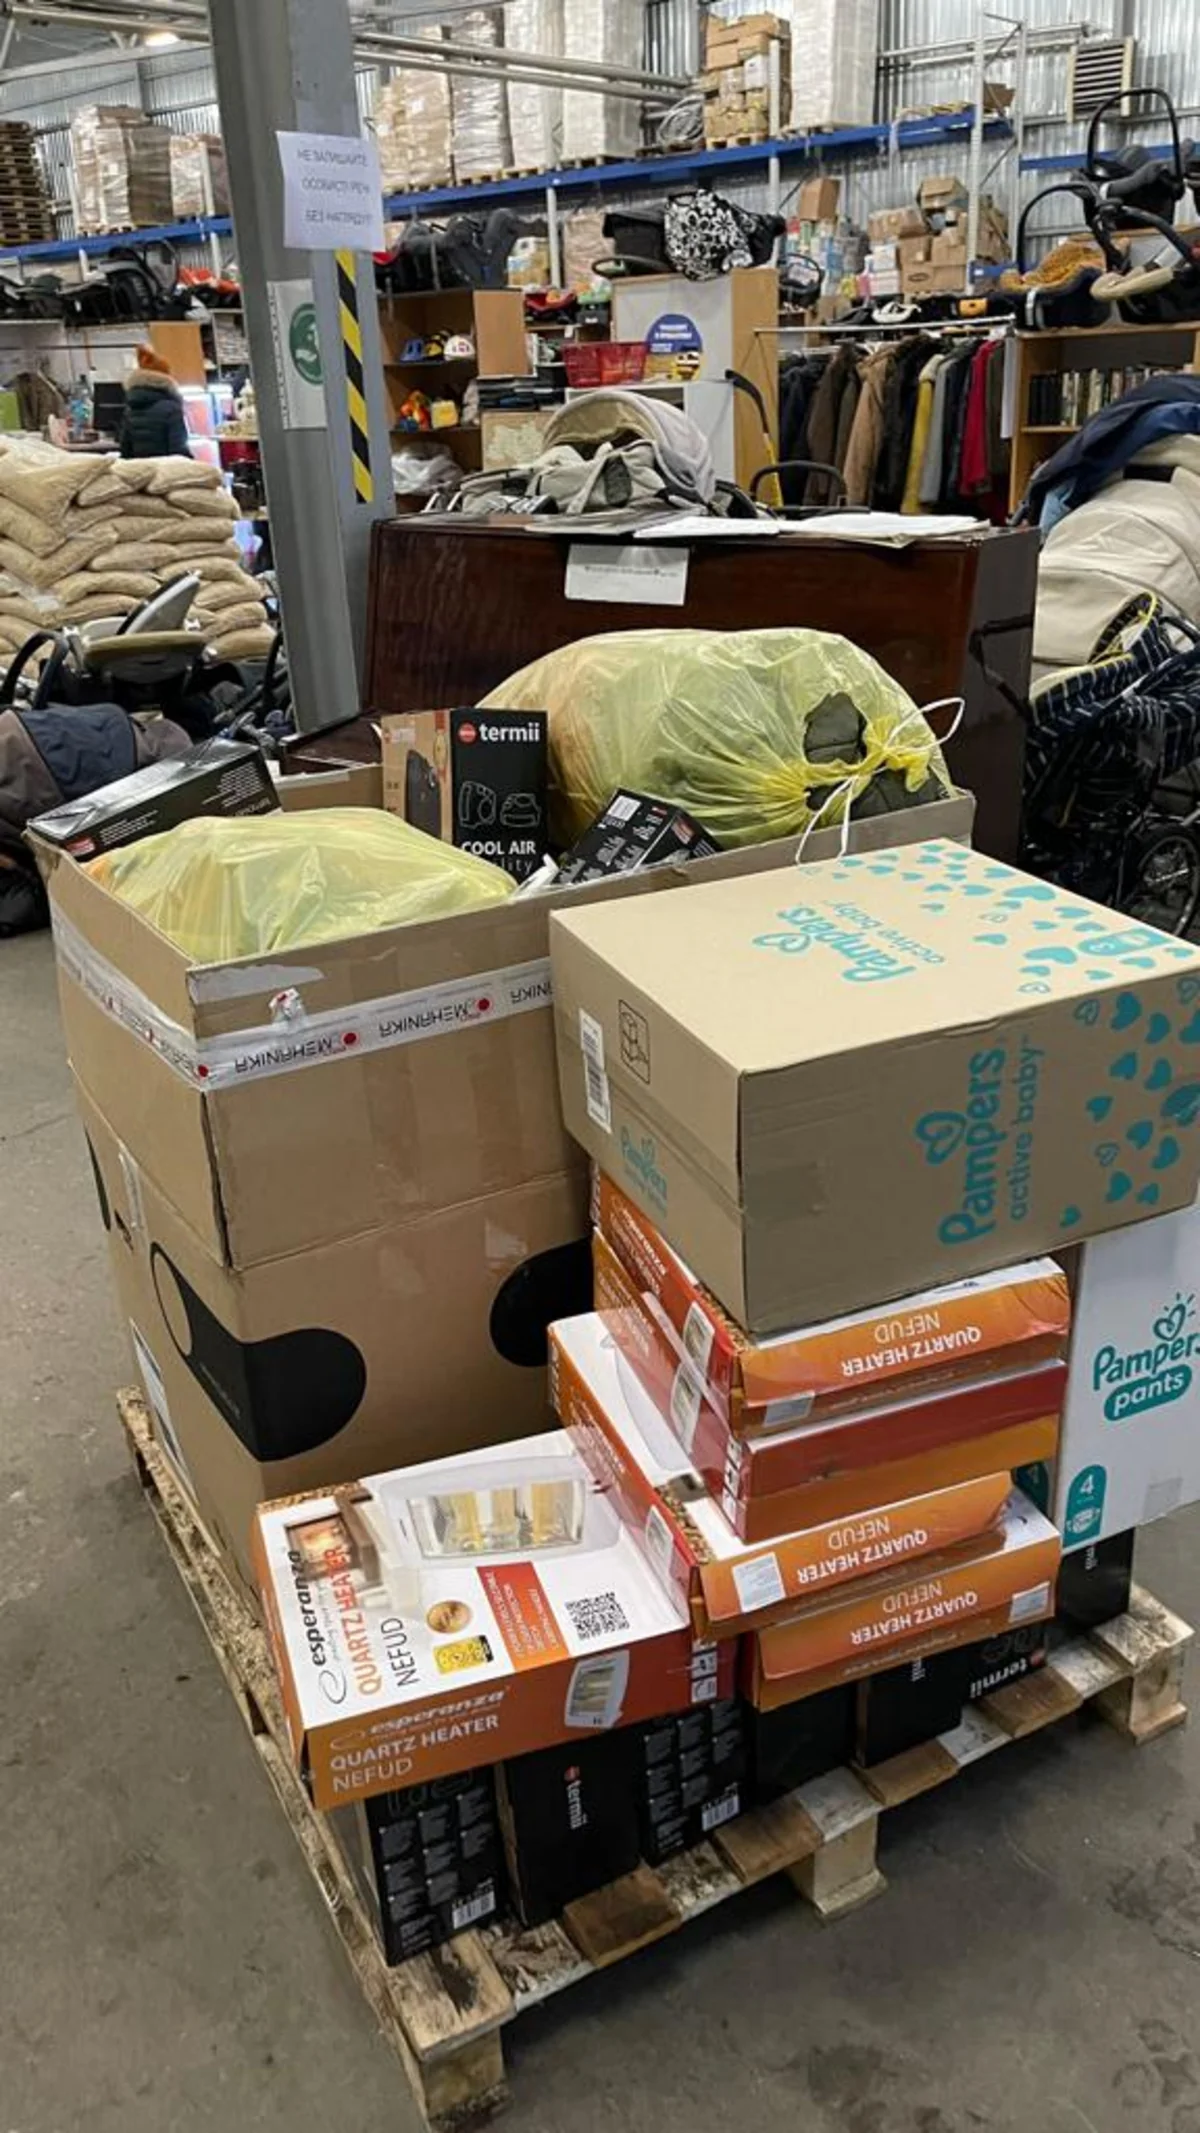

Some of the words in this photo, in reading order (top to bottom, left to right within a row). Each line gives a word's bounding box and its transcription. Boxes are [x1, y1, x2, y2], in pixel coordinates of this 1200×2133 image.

[479, 723, 541, 743] termii
[461, 841, 505, 855] COOL
[508, 840, 537, 855] AIR
[776, 907, 917, 982] Pampers
[1011, 1047, 1044, 1126] baby
[937, 1048, 1006, 1245] Pampers
[1005, 1131, 1034, 1221] active
[874, 1311, 941, 1344] NEFUD
[911, 1326, 982, 1356] QUARTZ
[841, 1344, 909, 1376] HEATER
[1093, 1333, 1200, 1392] Pamper
[1113, 1371, 1185, 1418] pants
[1080, 1474, 1094, 1495] 4
[828, 1516, 890, 1550] NEFUD
[863, 1529, 928, 1563] QUARTZ
[323, 1546, 359, 1613] HEATER
[797, 1553, 860, 1584] HEATER
[287, 1550, 327, 1667] esperanza
[882, 1580, 943, 1613] NEFUD
[914, 1591, 979, 1623] QUARTZ
[850, 1614, 912, 1645] HEATER
[341, 1612, 382, 1695] QUARTZ
[380, 1618, 421, 1687] NEFUD
[970, 1657, 1029, 1699] termii
[369, 1690, 505, 1736] esperanza
[330, 1736, 417, 1771] QUARTZ
[422, 1714, 500, 1748] HEATER
[332, 1758, 413, 1793] NEFUD
